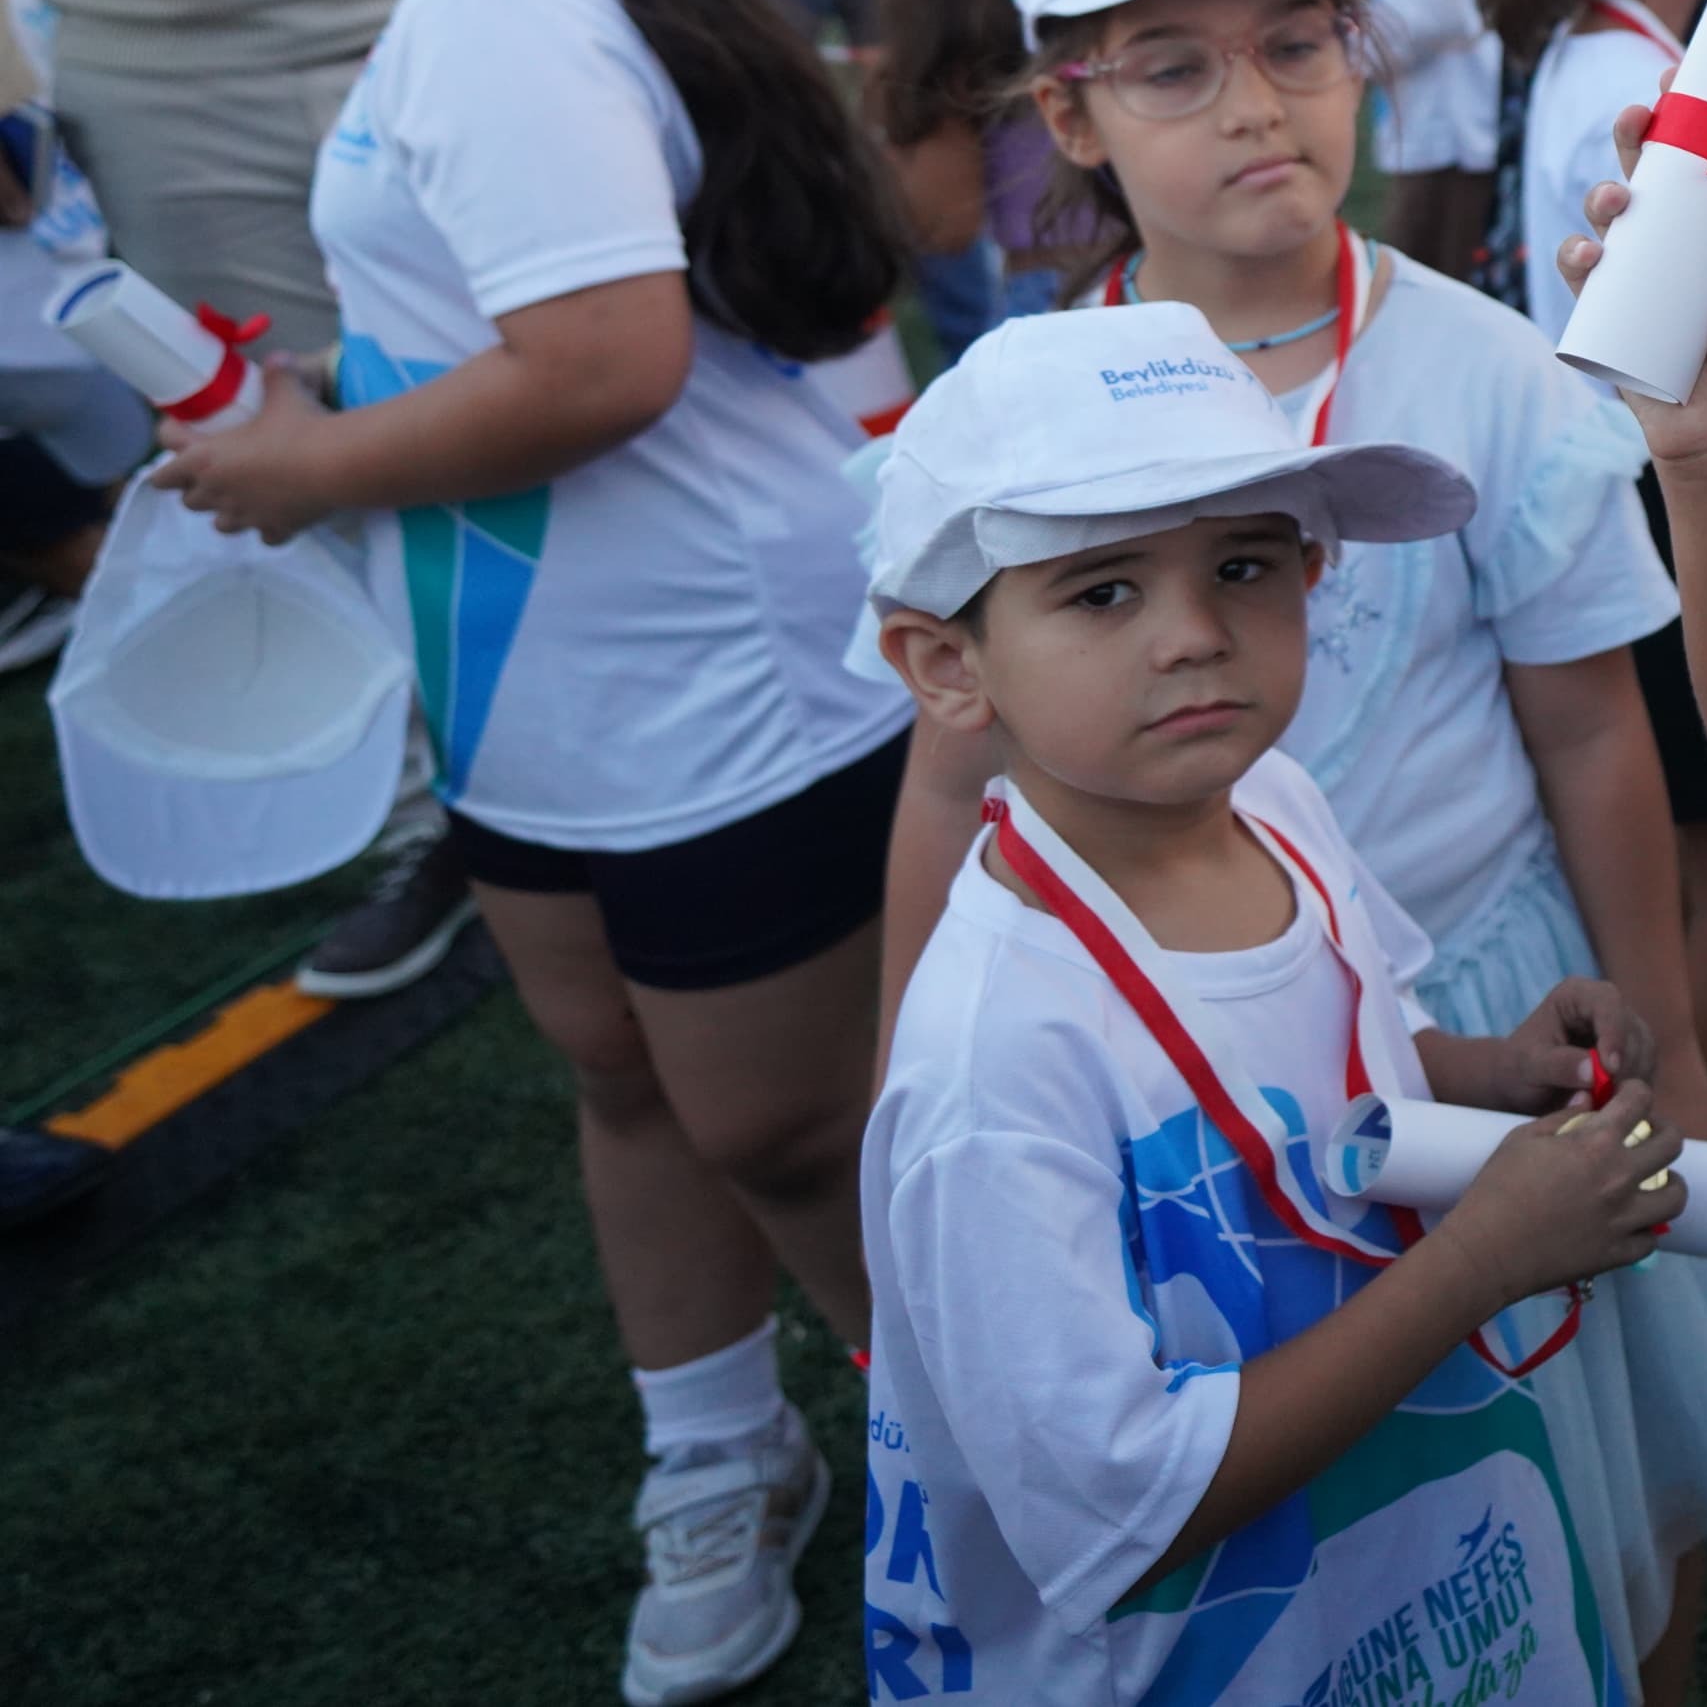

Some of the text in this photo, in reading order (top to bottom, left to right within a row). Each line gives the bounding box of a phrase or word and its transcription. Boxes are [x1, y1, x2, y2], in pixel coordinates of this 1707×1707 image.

[1100, 357, 1236, 386] Beylikdüzü
[1422, 1521, 1523, 1629] NEFES
[1438, 1560, 1534, 1670] UMUT
